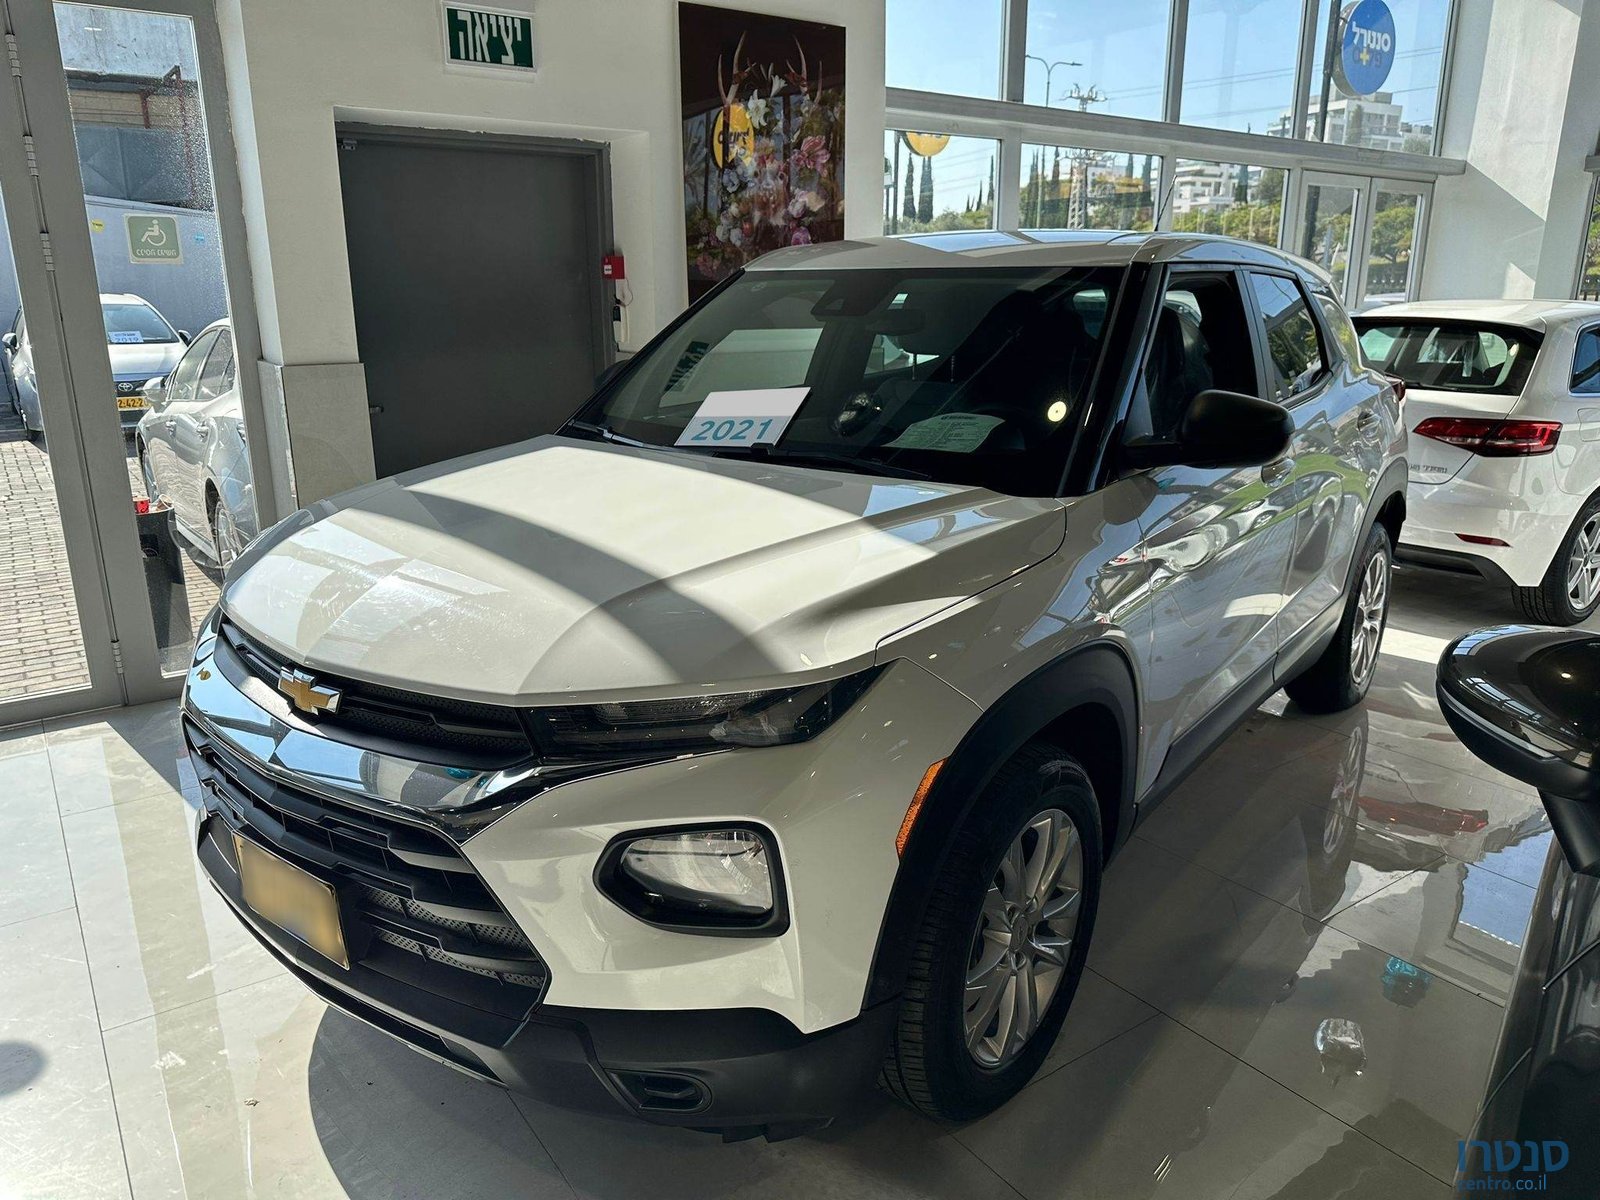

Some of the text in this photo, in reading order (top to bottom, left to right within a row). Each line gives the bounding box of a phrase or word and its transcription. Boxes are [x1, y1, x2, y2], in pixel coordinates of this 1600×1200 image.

[457, 10, 522, 65] יציאה
[1352, 21, 1391, 52] סנטרל
[691, 418, 773, 440] 2021
